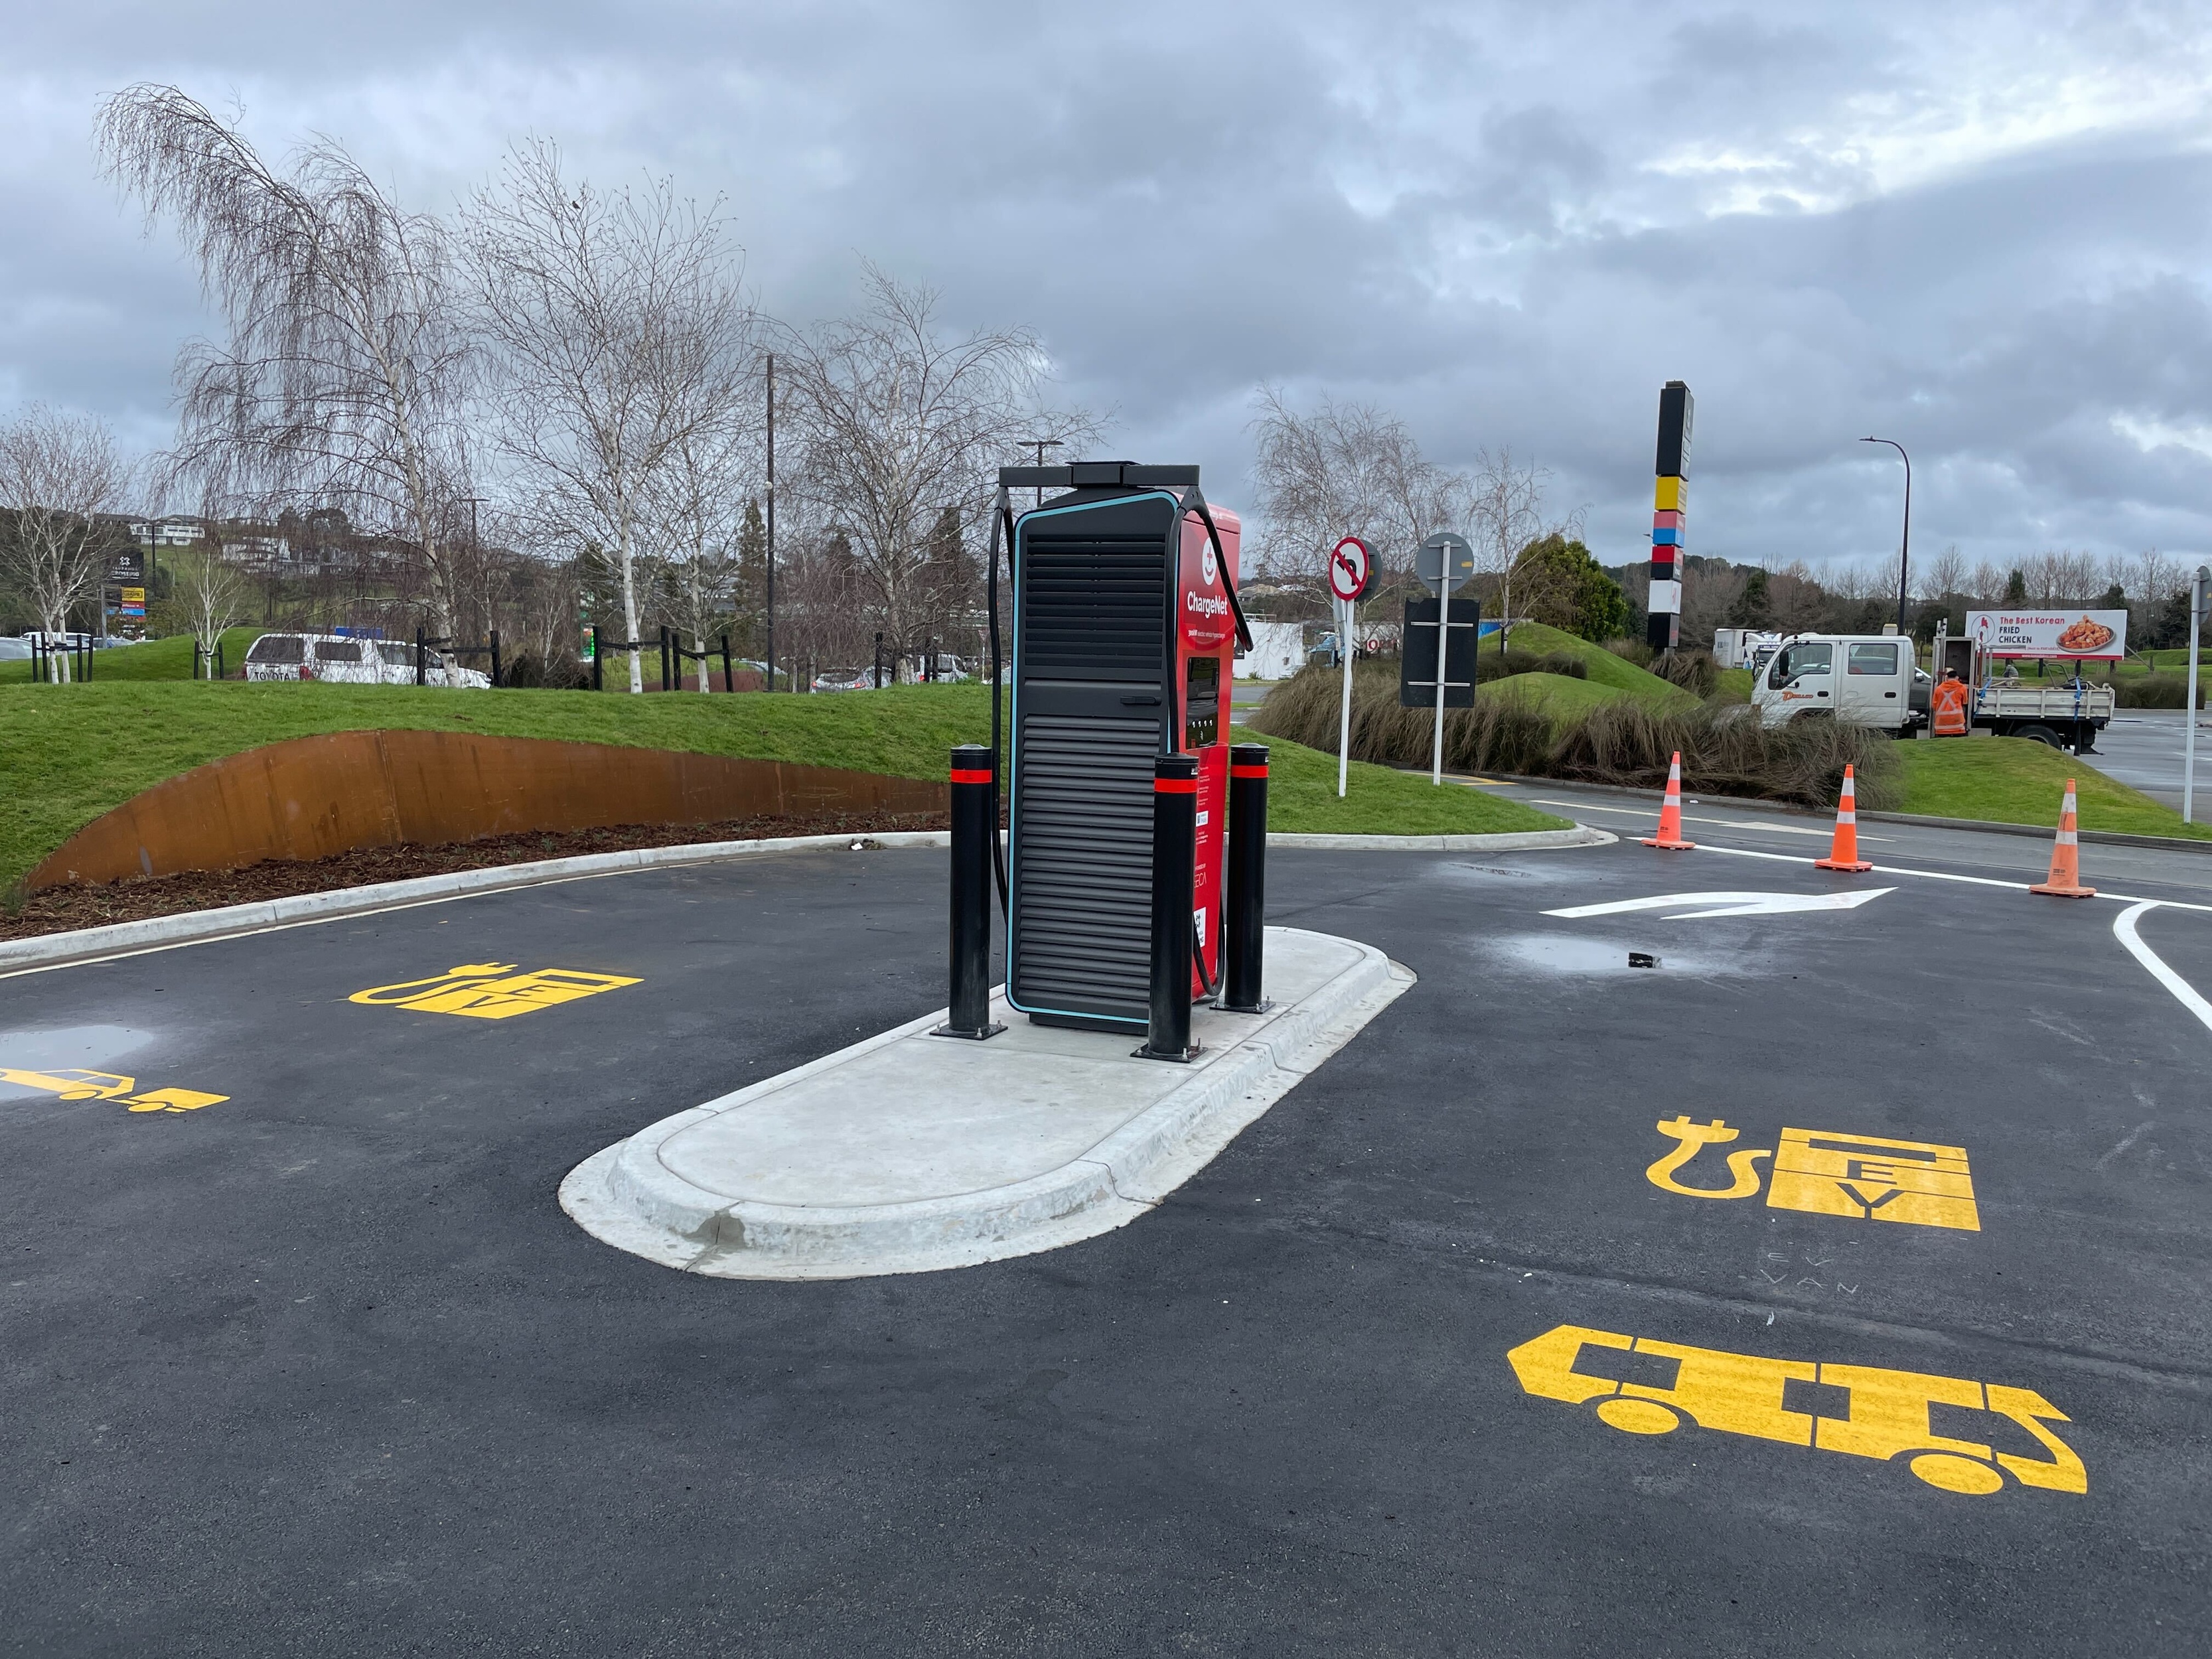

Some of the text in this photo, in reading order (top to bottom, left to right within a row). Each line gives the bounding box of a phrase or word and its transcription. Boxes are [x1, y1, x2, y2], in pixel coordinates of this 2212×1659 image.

[1187, 591, 1228, 618] ChargeNet
[256, 672, 290, 681] TOYOTA
[1195, 871, 1207, 888] ECA
[1760, 1269, 1859, 1294] VAN
